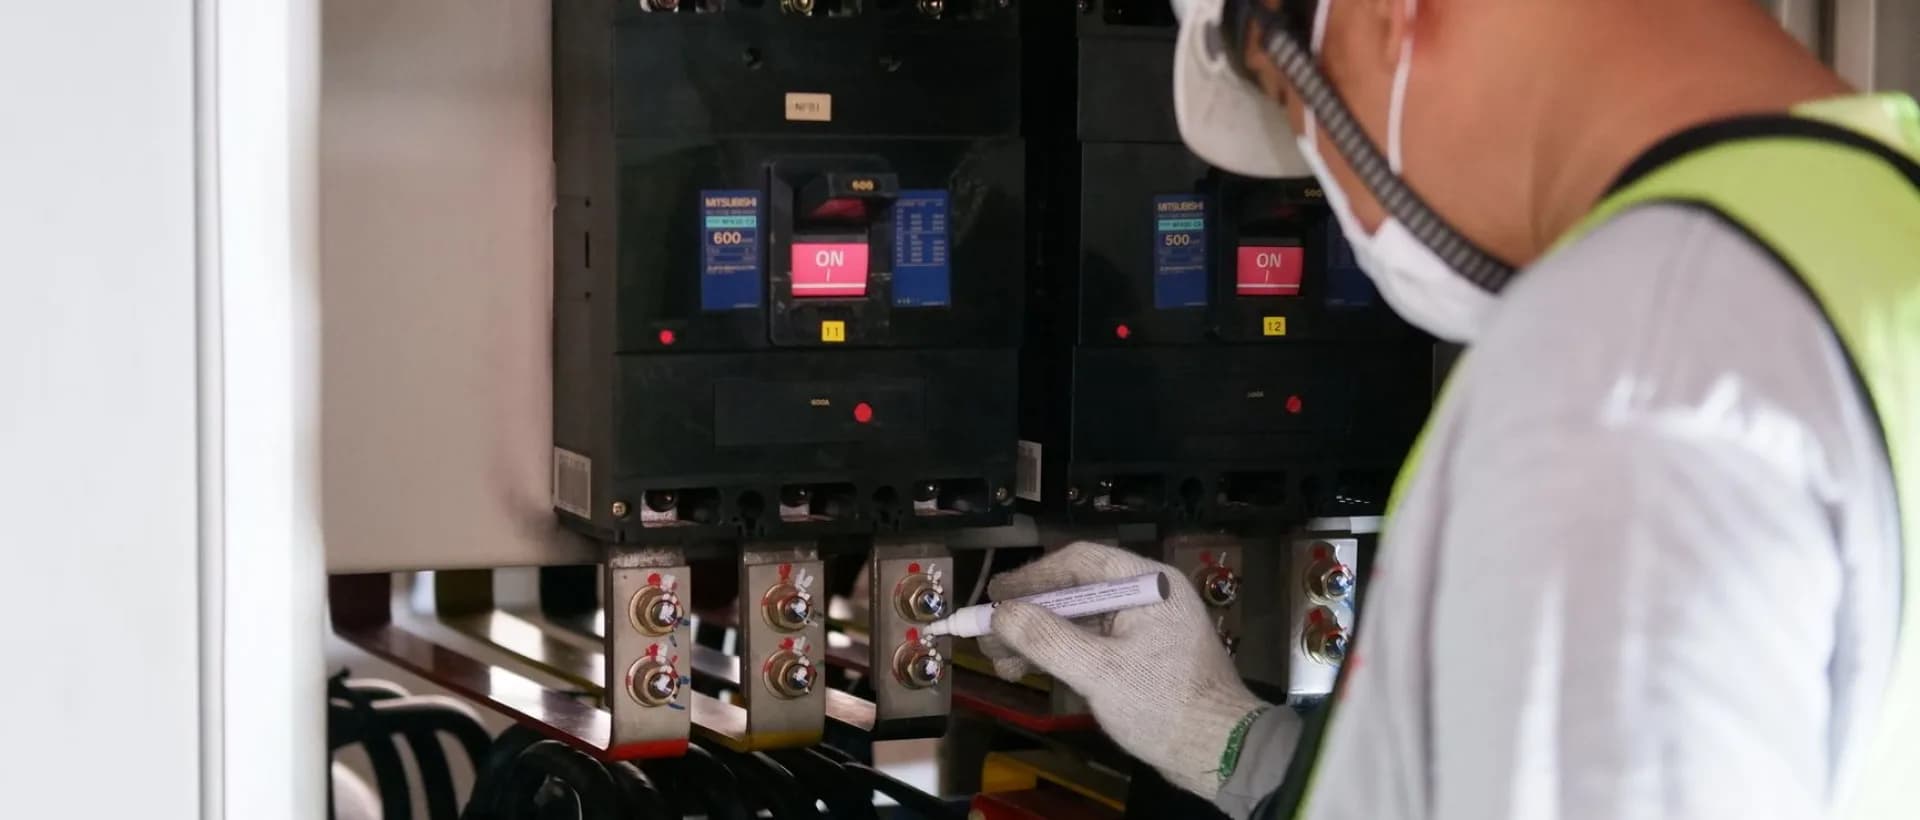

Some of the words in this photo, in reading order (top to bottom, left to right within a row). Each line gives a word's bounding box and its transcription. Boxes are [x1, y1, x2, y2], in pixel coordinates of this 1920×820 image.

[713, 231, 742, 245] 600
[1165, 234, 1190, 247] 500
[815, 250, 844, 267] ON
[1256, 252, 1282, 268] ON
